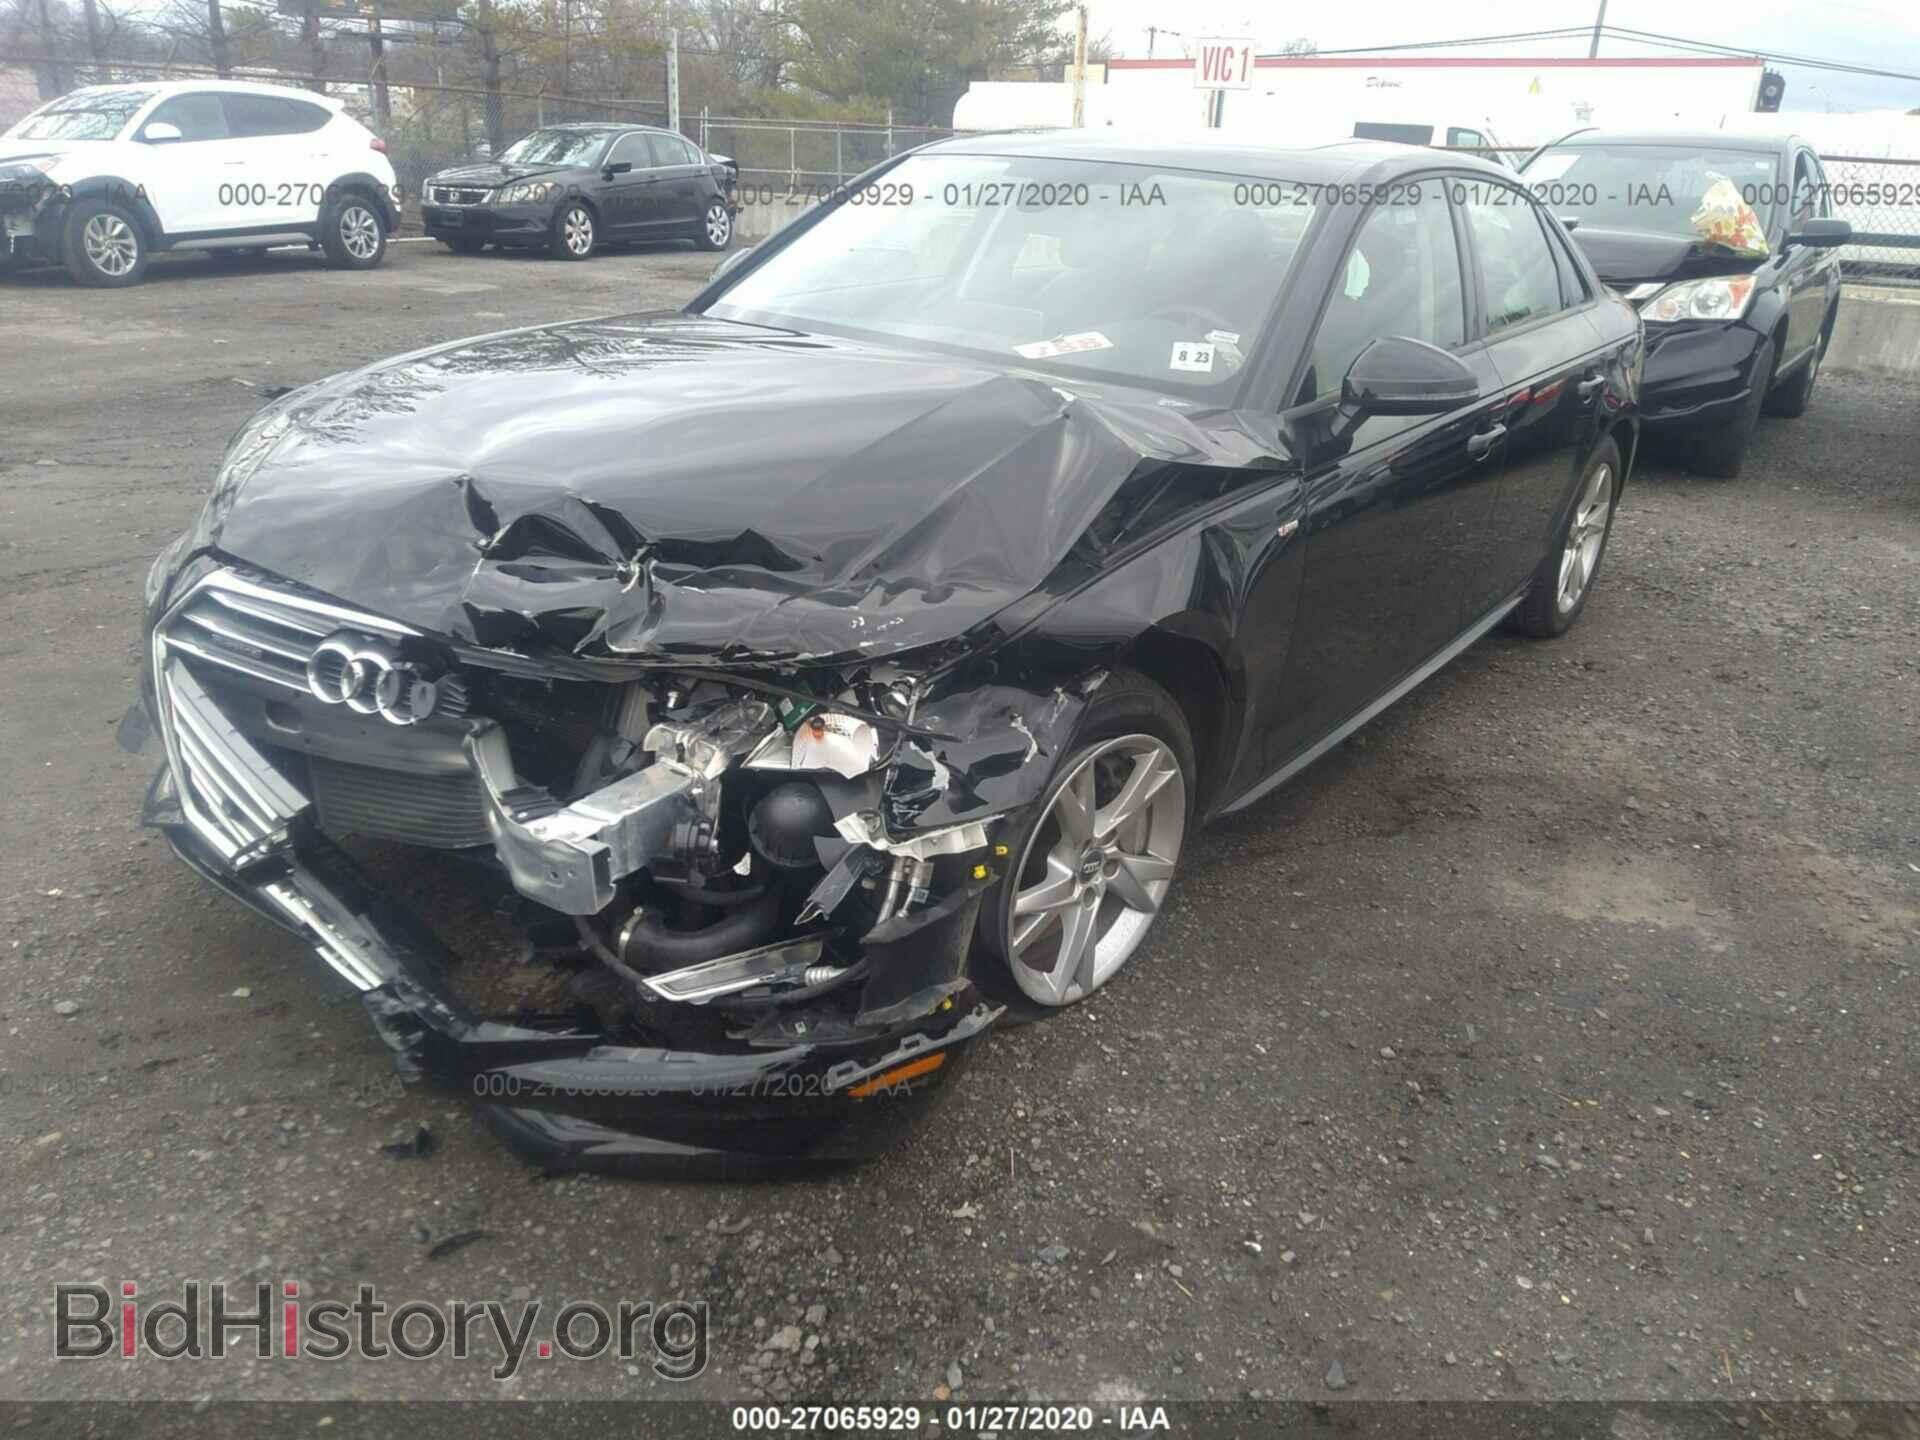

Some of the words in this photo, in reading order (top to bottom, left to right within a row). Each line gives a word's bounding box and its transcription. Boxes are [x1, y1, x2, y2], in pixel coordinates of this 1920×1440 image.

[1202, 46, 1235, 82] VIC
[1240, 46, 1249, 82] 1
[1194, 351, 1209, 363] 23
